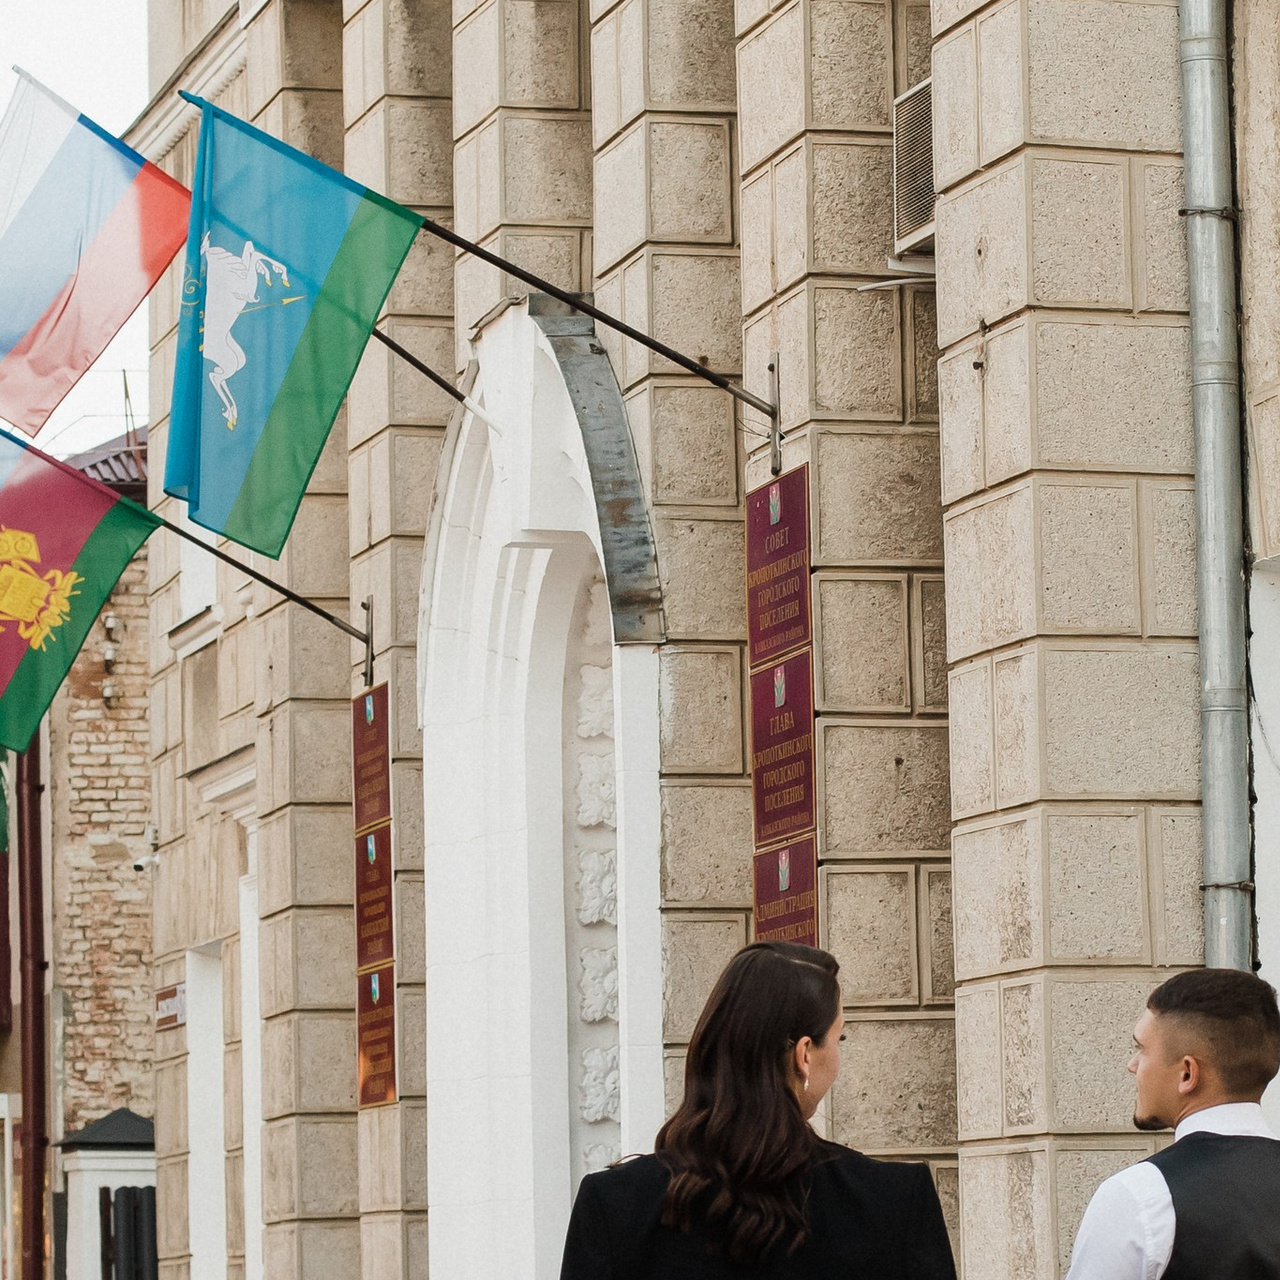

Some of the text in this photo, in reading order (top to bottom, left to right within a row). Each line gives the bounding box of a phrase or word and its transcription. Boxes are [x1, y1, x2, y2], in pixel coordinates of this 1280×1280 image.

[765, 527, 790, 554] СОВЕТ
[748, 548, 808, 589] КРОПОТКИНСКОГО
[758, 576, 800, 608] ГОРОДСКОГО
[759, 600, 800, 631] ПОСЕЛЕНИЯ
[770, 711, 795, 736] ГЛАВА
[752, 732, 812, 770] КРОПОТКИНСКОГО
[763, 760, 805, 790] ГОРОДСКОГО
[764, 784, 805, 813] ПОСЕЛЕНИЯ
[756, 889, 815, 922] АДМИНИСТРАЦИЯ
